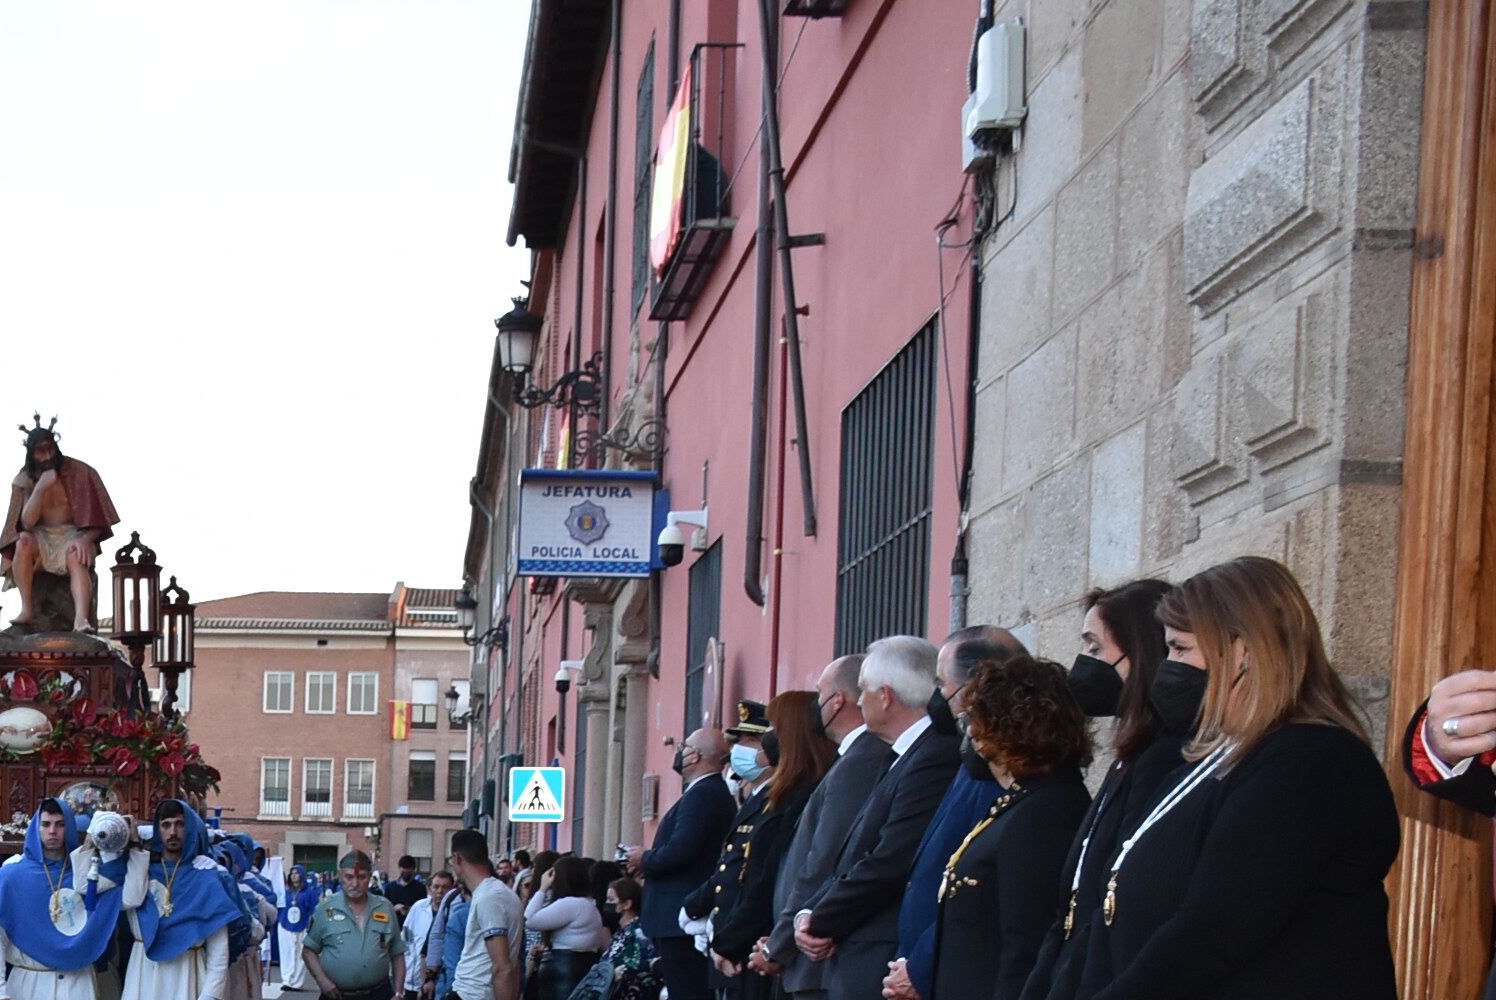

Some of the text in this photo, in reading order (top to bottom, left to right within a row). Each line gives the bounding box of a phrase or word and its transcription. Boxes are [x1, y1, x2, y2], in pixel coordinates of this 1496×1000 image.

[542, 485, 633, 498] JEFATURA
[531, 546, 639, 559] POLICIA LOCAL
